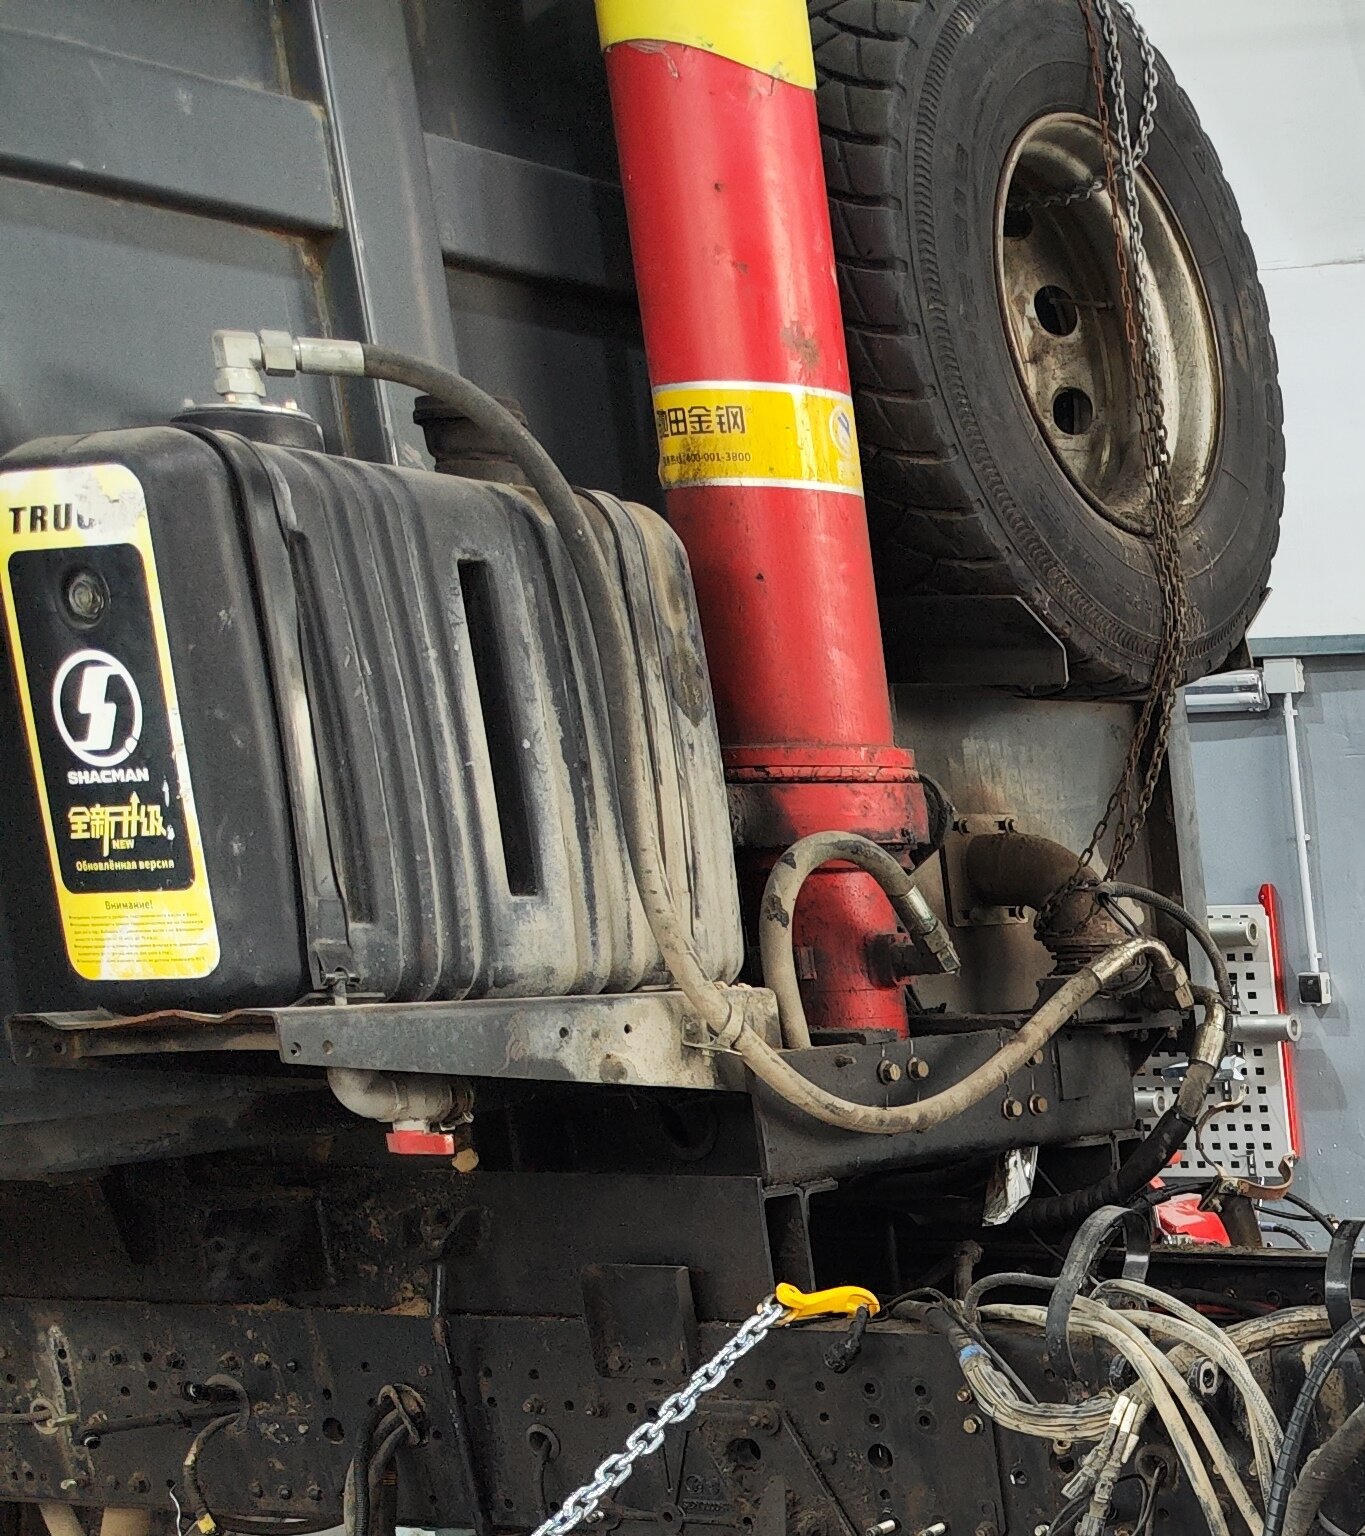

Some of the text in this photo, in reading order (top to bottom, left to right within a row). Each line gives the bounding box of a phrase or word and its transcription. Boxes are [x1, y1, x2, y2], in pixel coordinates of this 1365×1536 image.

[67, 767, 149, 785] SHACMAN
[112, 838, 135, 850] NEW
[105, 900, 154, 911] Внимание!
